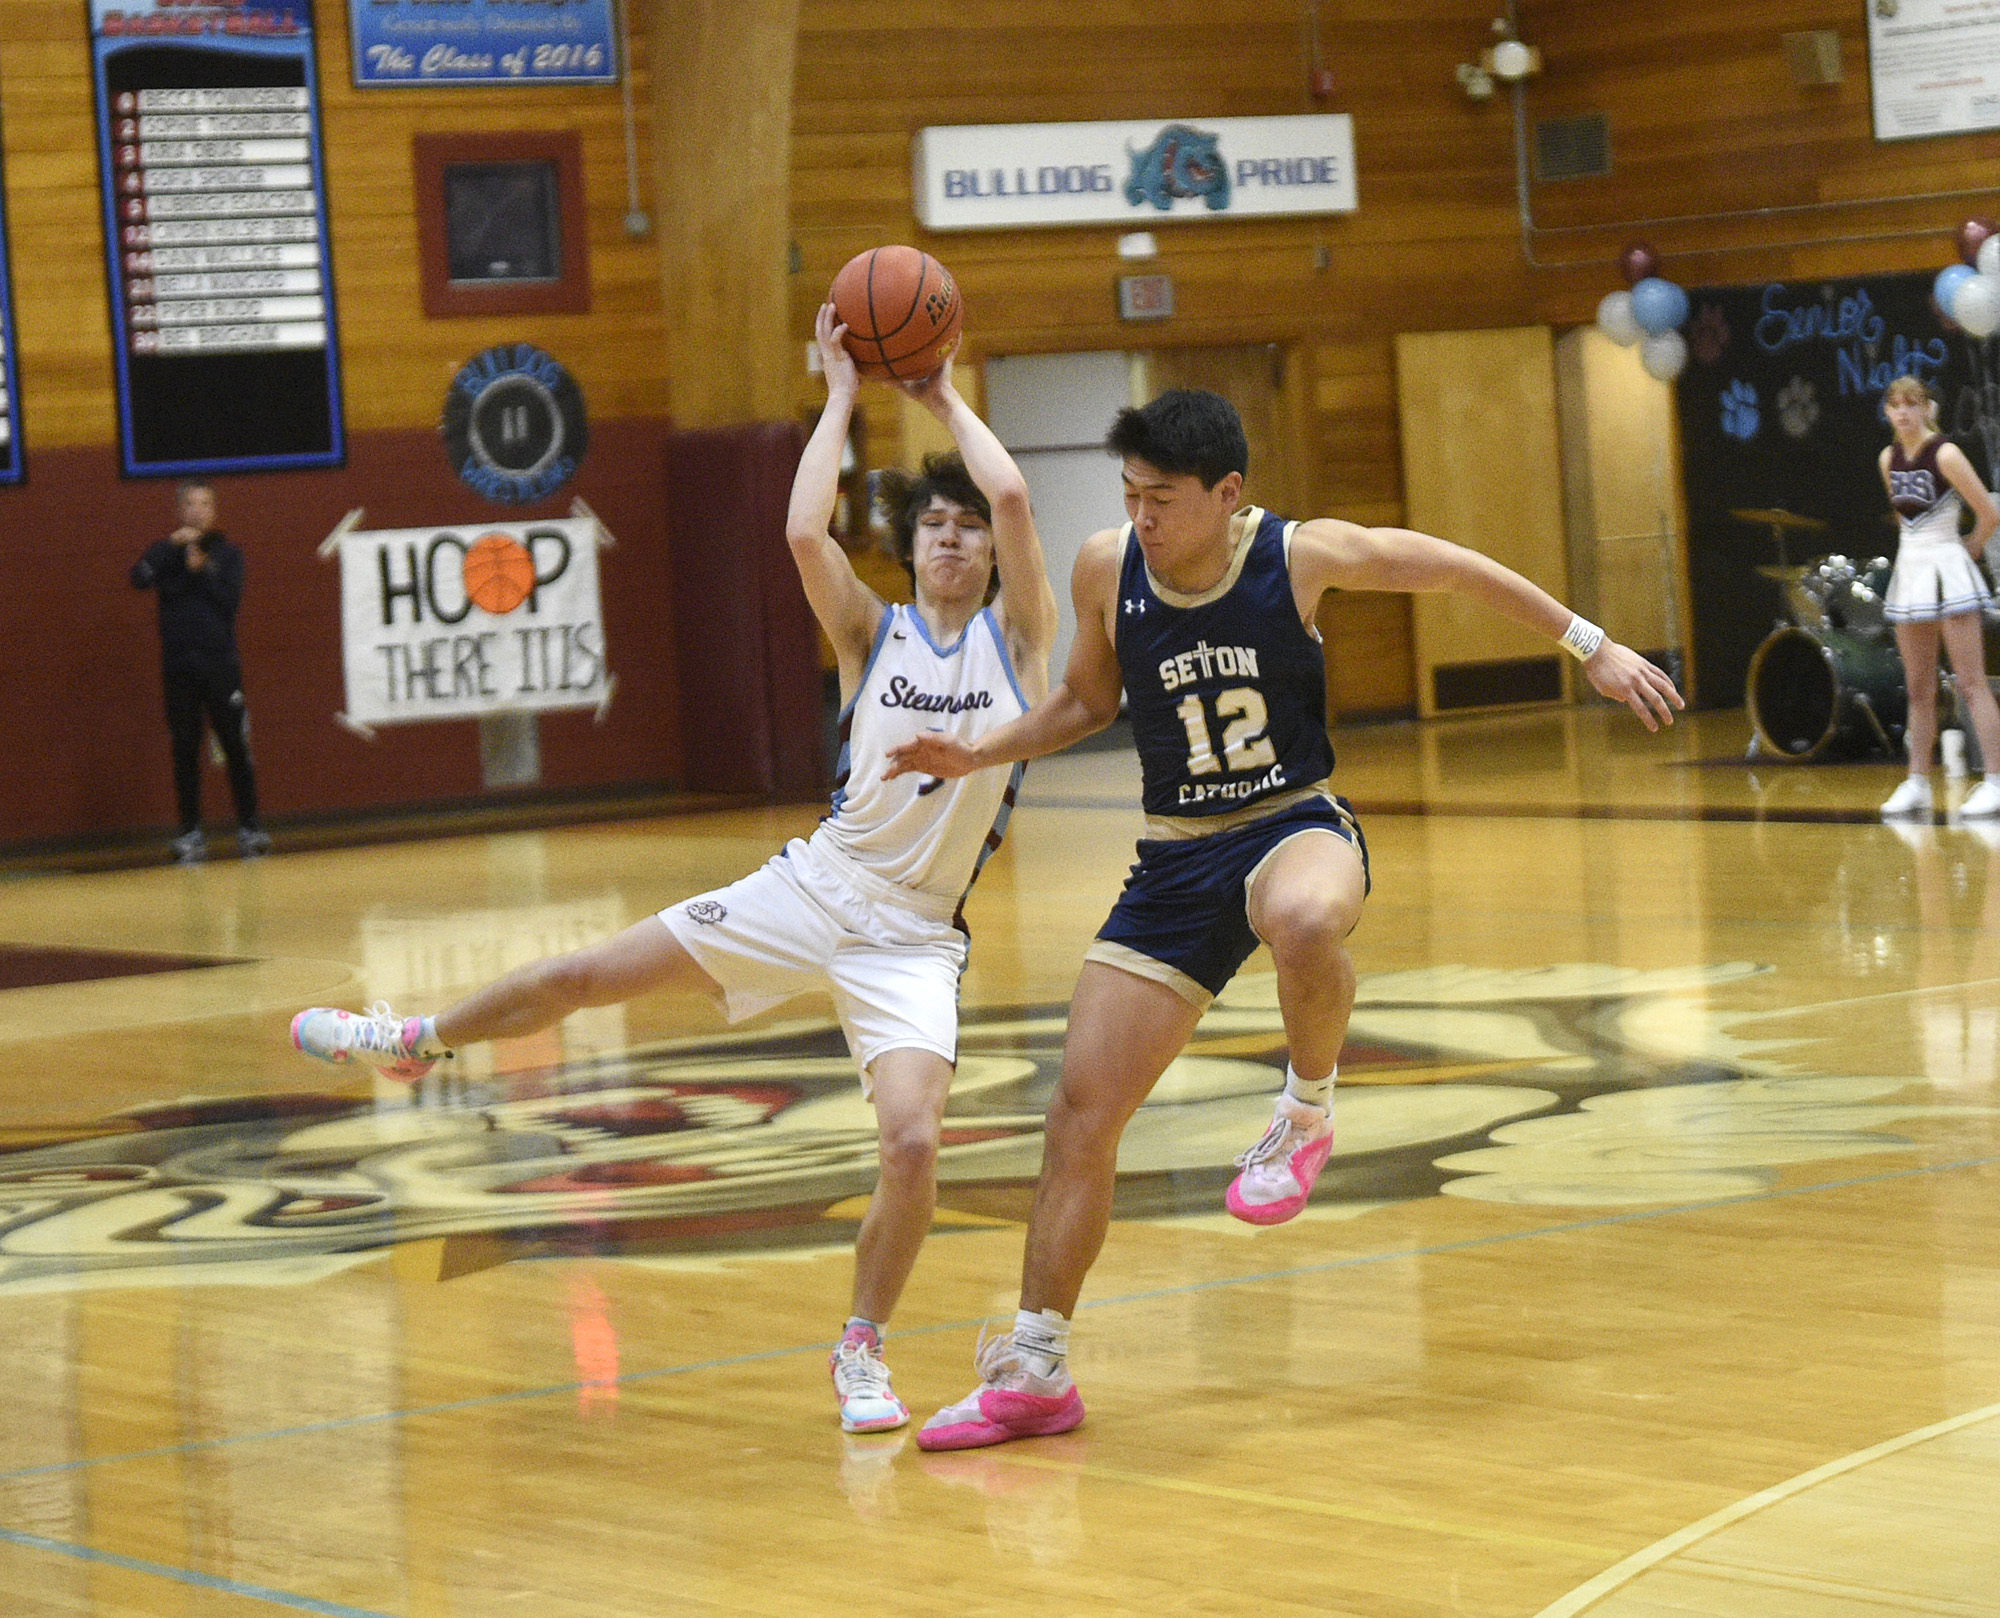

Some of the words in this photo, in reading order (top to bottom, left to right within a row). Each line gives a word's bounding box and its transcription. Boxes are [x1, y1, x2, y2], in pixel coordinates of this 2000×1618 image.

[367, 43, 415, 71] The
[420, 43, 494, 74] Class
[500, 45, 527, 76] of
[533, 43, 602, 69] 2016
[944, 164, 1111, 199] BULLDOG
[1237, 156, 1338, 188] PRIDE
[377, 526, 571, 625] HOOP
[375, 631, 498, 702] THERE
[1159, 640, 1260, 690] SETON
[1176, 687, 1277, 776] 12
